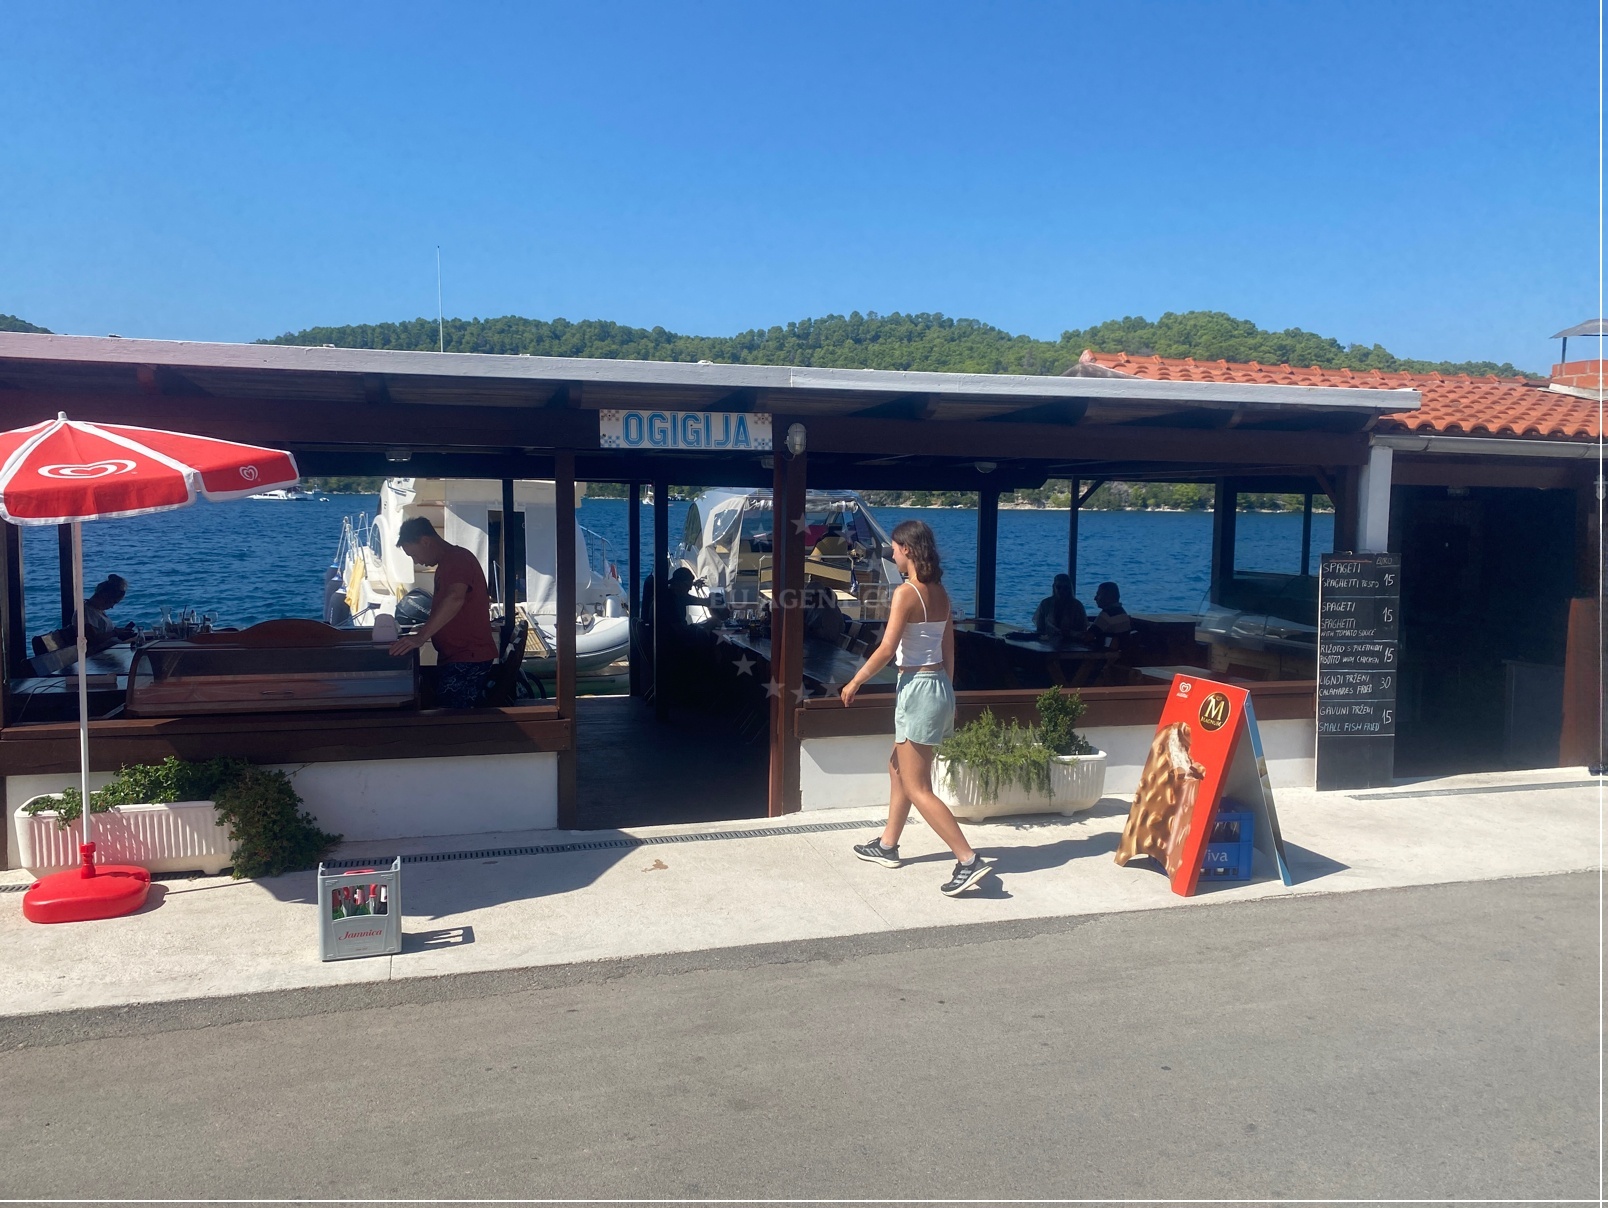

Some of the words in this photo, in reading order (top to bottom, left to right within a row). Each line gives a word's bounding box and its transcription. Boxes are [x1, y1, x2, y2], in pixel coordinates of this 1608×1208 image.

[623, 411, 752, 448] OGIGIJA
[1323, 563, 1360, 573] SPAGETI
[1322, 578, 1359, 588] SPAGHETTI
[1384, 574, 1395, 586] 15
[1321, 602, 1356, 612] SPAGETI
[1383, 607, 1393, 622] 15
[1321, 618, 1356, 629] SPAGHETTI
[1384, 647, 1395, 663] 15
[1320, 675, 1343, 685] LIGNJI
[1379, 676, 1392, 689] 30
[1320, 706, 1349, 716] GAVUNI
[1382, 709, 1393, 724] 15
[1319, 722, 1341, 732] SMALL
[1344, 722, 1362, 732] FISH
[1206, 849, 1228, 862] iva
[338, 929, 382, 940] Jamnica
